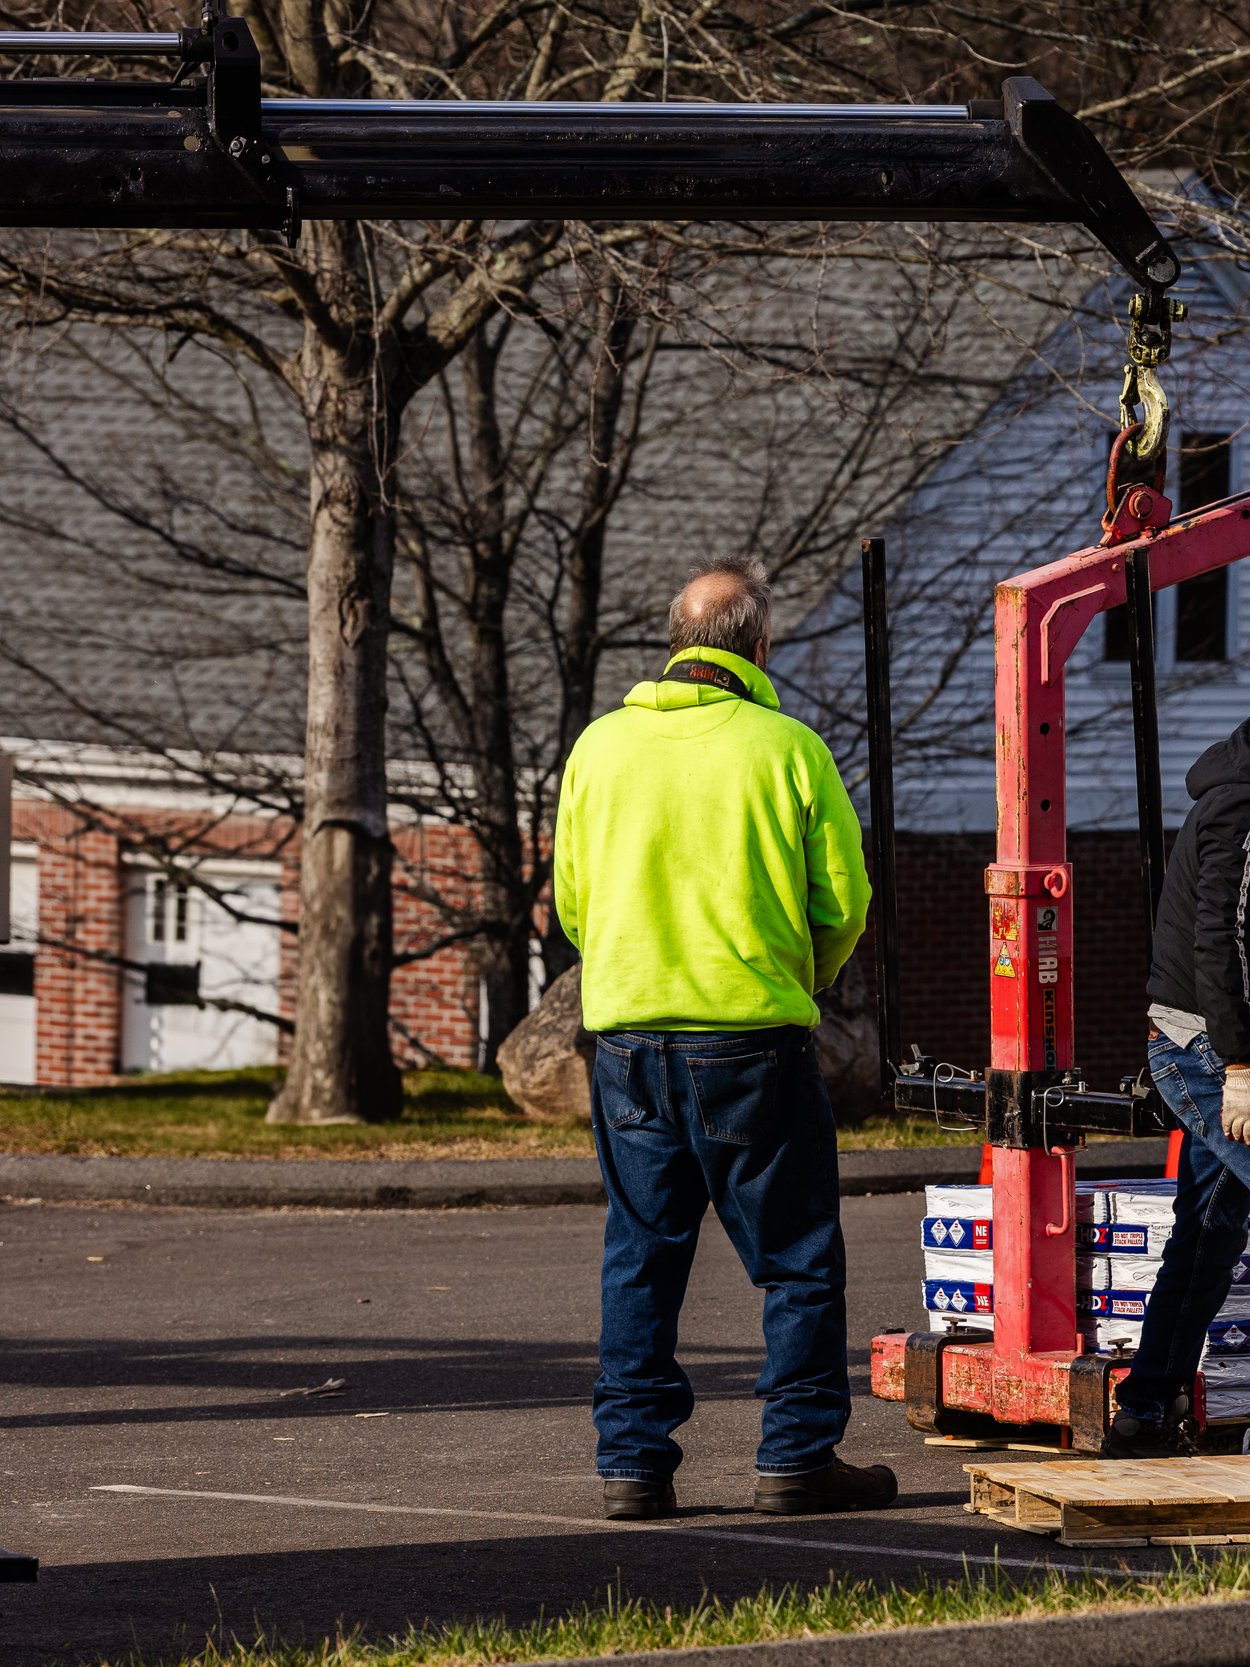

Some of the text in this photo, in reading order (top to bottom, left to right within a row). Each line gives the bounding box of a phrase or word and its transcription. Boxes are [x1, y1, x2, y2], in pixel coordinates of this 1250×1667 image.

[1038, 935, 1058, 984] HIAB
[1044, 989, 1055, 1070] KINSHO
[976, 1226, 987, 1236] NE
[977, 1296, 989, 1306] NE
